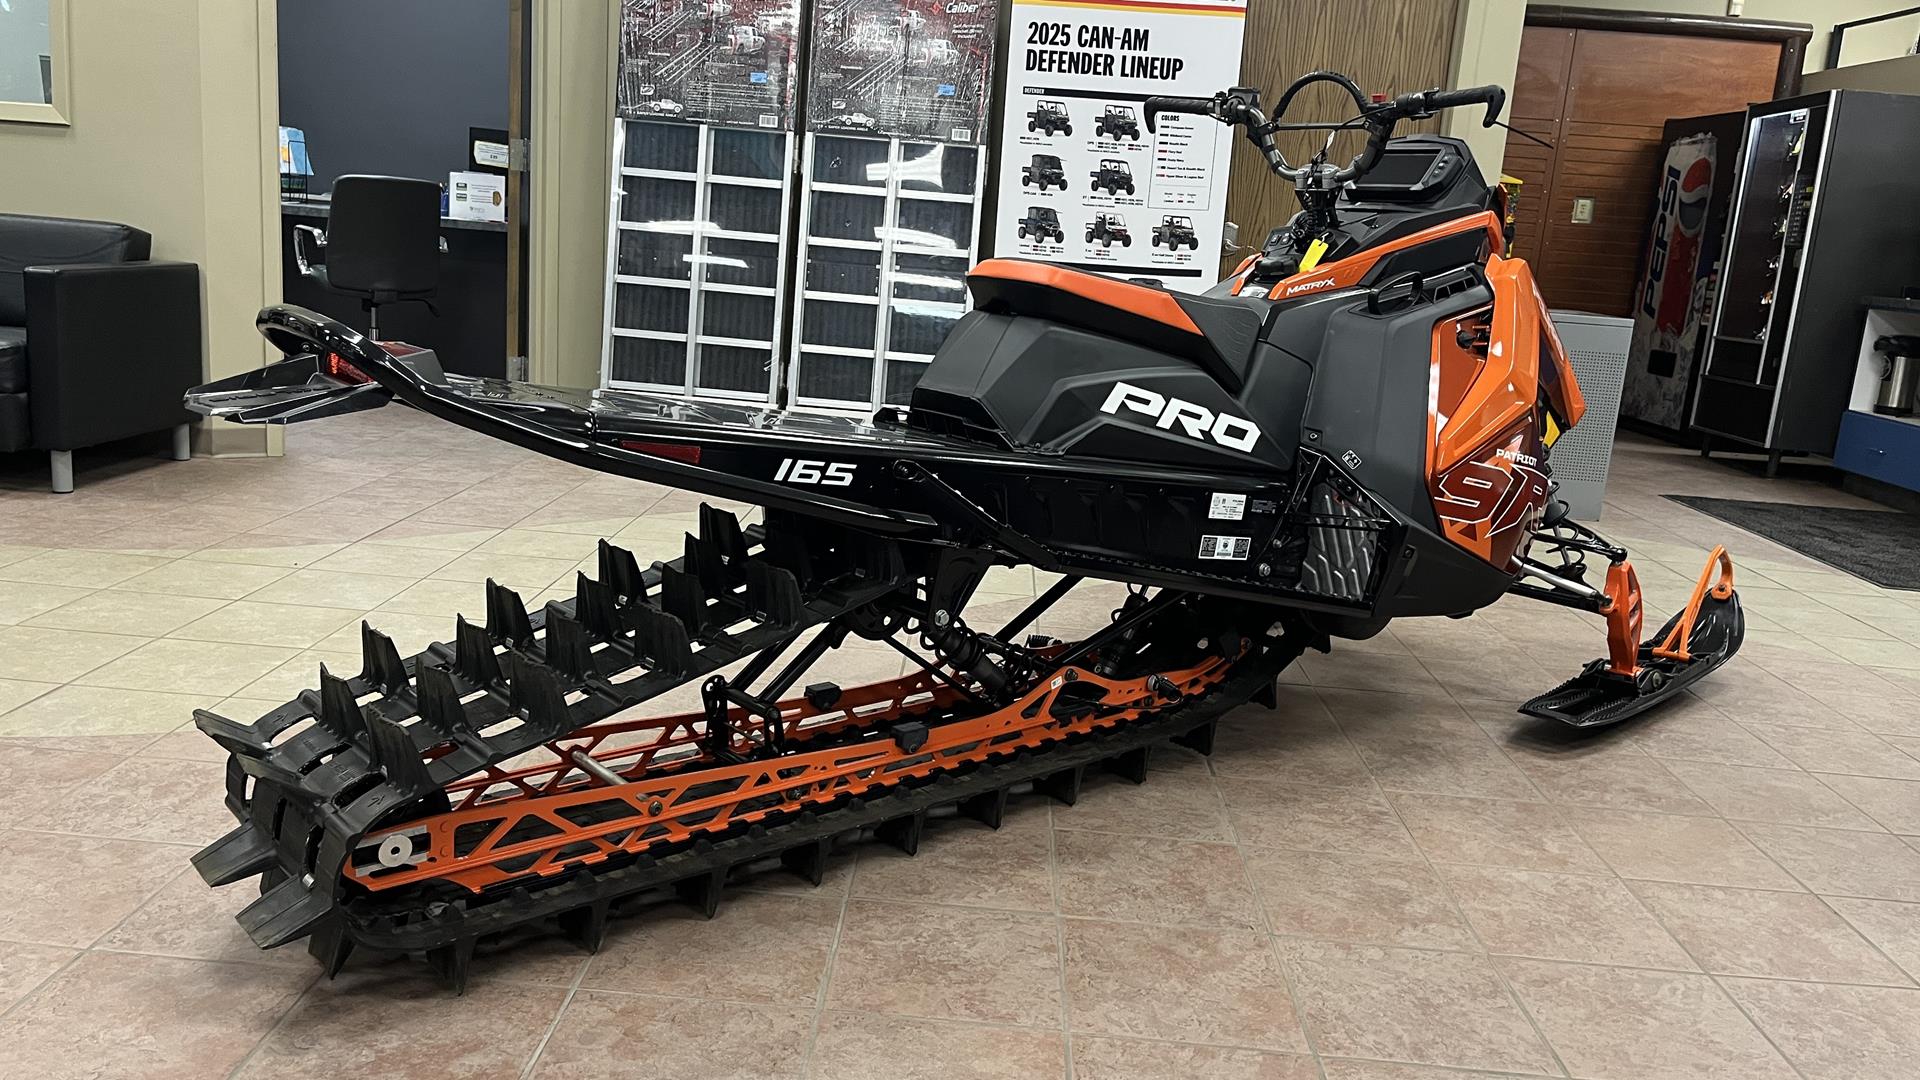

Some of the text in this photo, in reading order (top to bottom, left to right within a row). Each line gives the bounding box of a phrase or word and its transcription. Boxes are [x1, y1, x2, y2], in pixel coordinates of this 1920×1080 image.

[945, 1, 979, 14] Caliber
[1027, 21, 1150, 51] 2025 CAN-AM
[1025, 50, 1184, 80] DEFENDER LINEUP
[1024, 87, 1045, 95] DEFENDER
[1643, 164, 1681, 320] PEPSI
[1286, 277, 1336, 296] MATRYX
[1099, 381, 1262, 453] PRO
[1495, 448, 1538, 467] PATRIOT
[773, 458, 858, 487] 165
